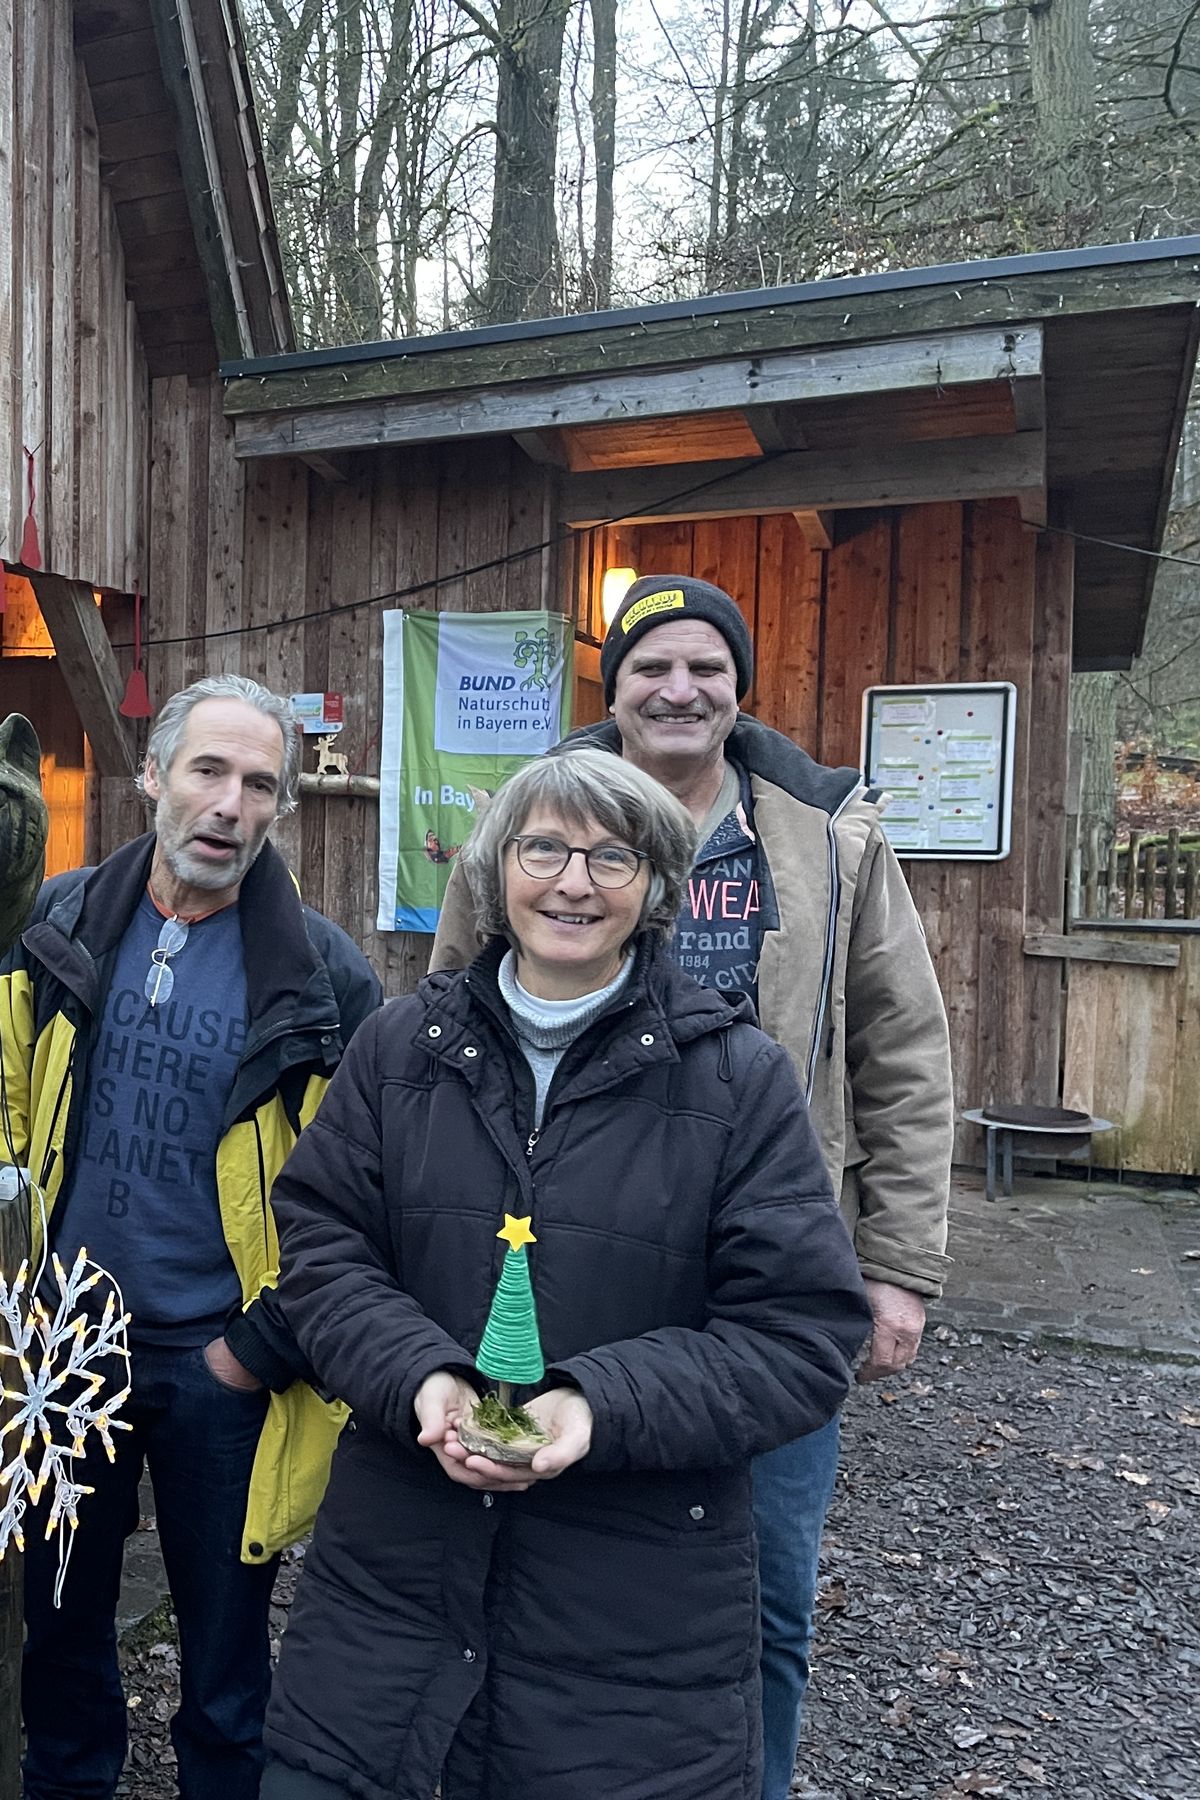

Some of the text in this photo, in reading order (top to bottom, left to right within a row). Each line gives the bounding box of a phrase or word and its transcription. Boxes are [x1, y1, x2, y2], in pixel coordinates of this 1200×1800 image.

[460, 675, 516, 692] BUND
[458, 715, 471, 730] in
[475, 716, 528, 734] Bayern
[414, 784, 476, 813] In Bay
[688, 878, 760, 921] WEA
[680, 926, 751, 951] rand
[679, 954, 710, 969] 1984
[102, 1031, 212, 1096] HERE
[133, 1087, 190, 1137] NO
[107, 1178, 131, 1219] B
